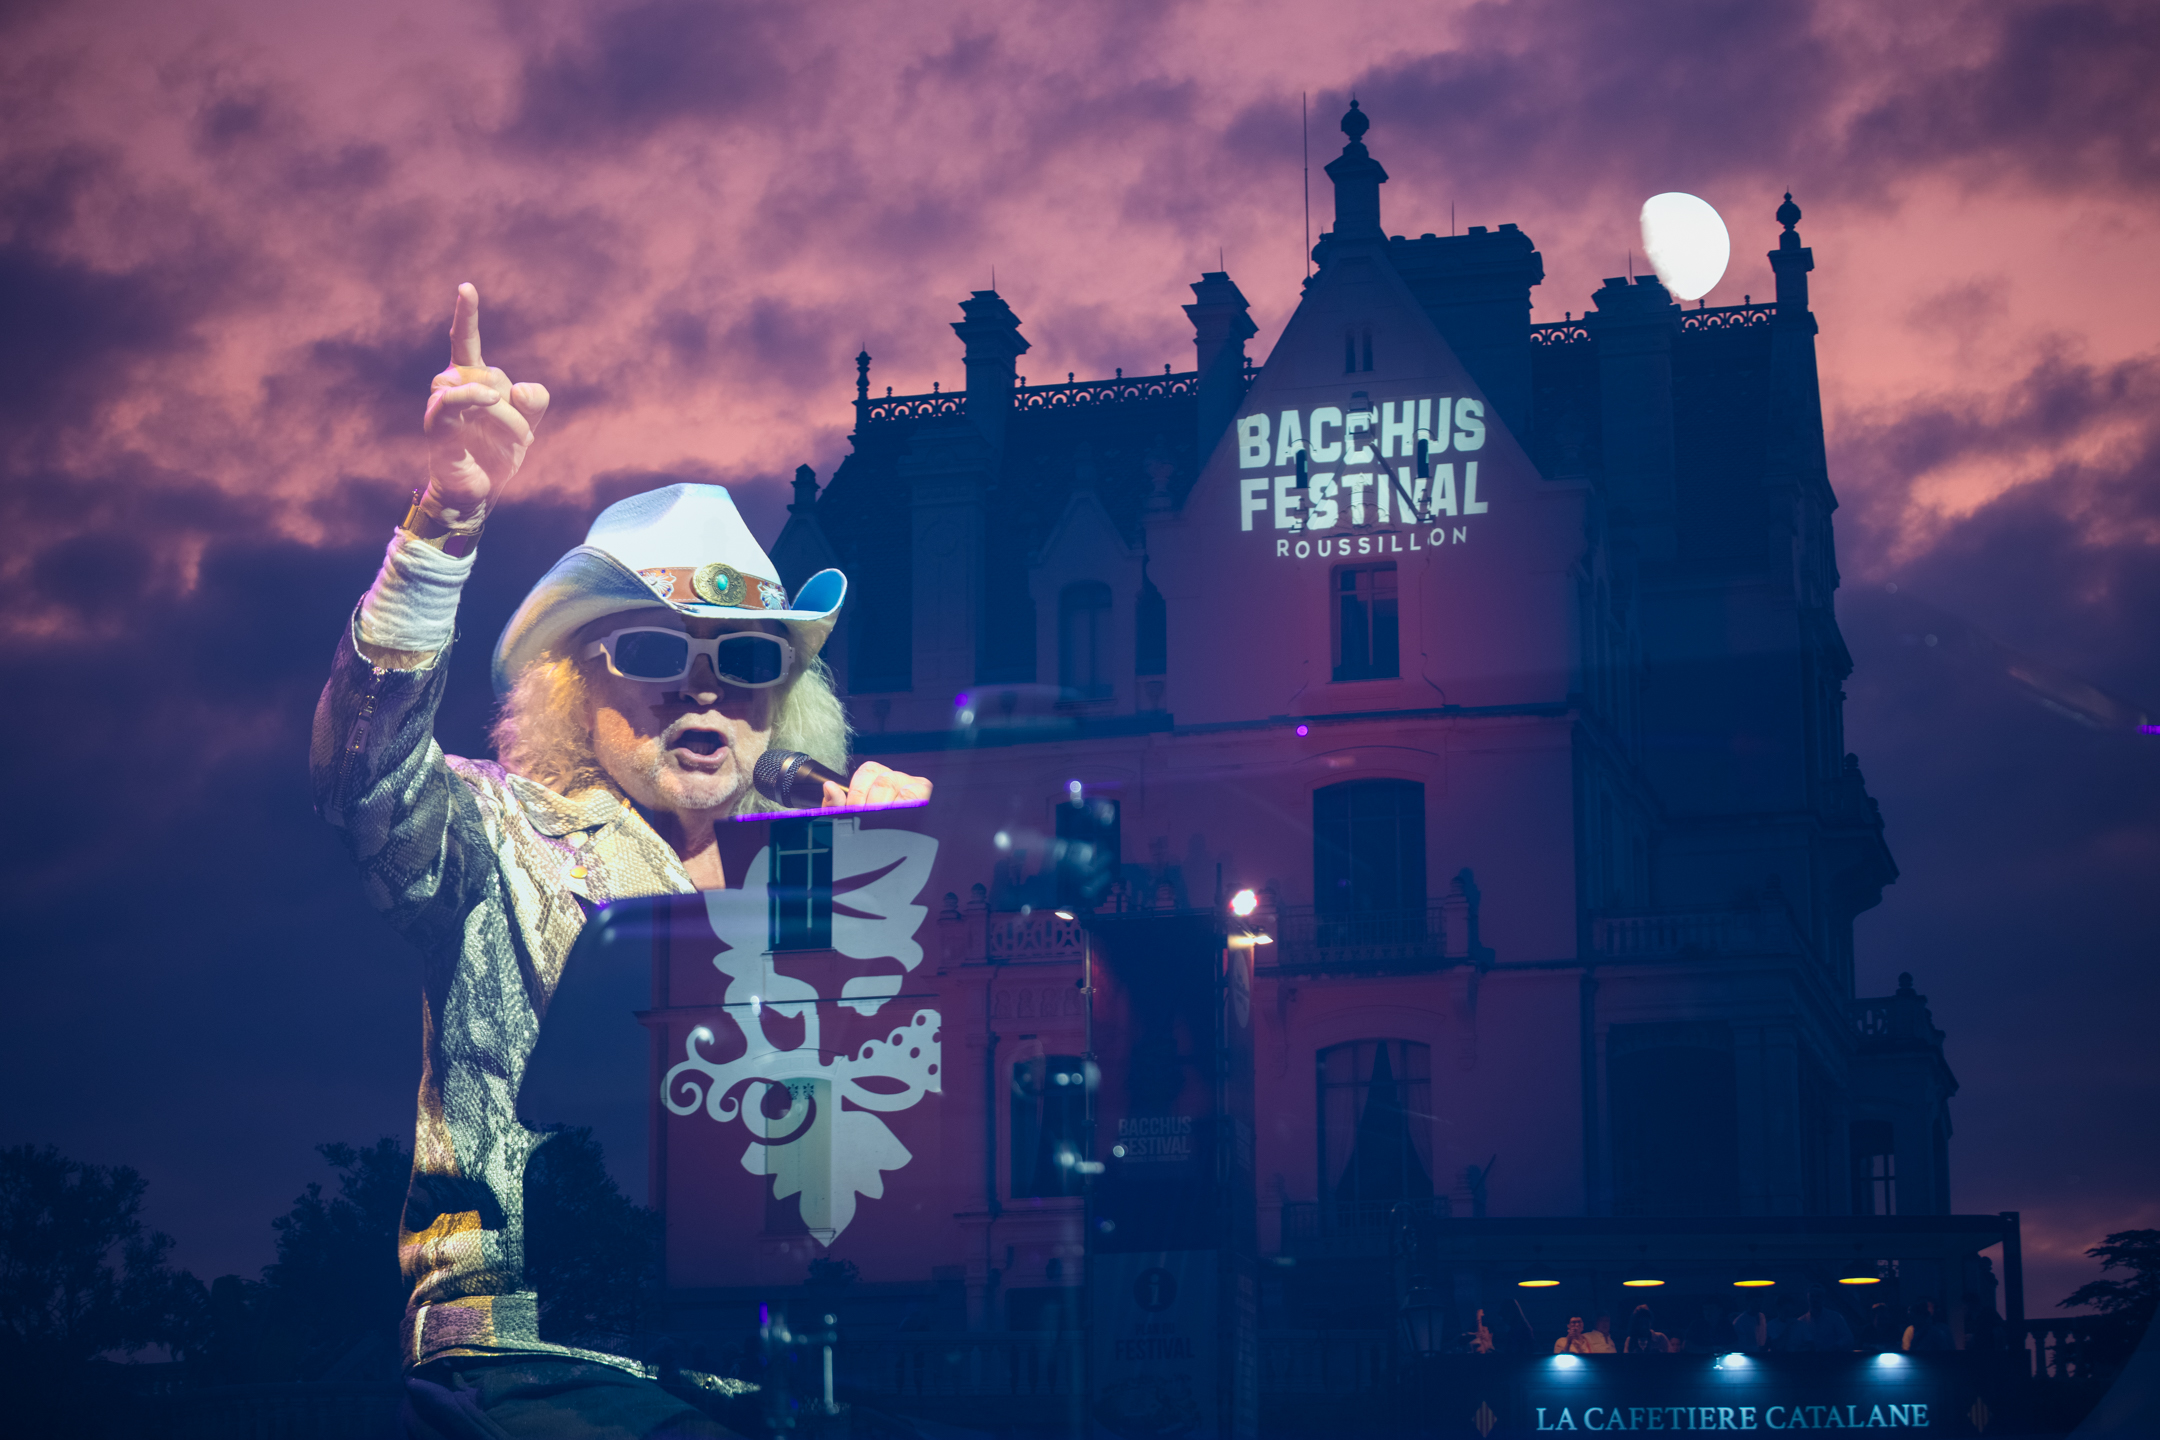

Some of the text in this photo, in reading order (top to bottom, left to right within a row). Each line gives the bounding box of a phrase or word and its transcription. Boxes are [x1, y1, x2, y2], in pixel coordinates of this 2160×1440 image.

[1237, 397, 1486, 469] BACCHUS
[1240, 461, 1488, 531] FESTIVAL
[1276, 526, 1467, 558] ROUSSILLON
[1118, 1115, 1192, 1136] BACCHUS
[1115, 1337, 1196, 1362] FESTIVAL
[1536, 1404, 1930, 1430] LA CAFETIERE CATALANE
